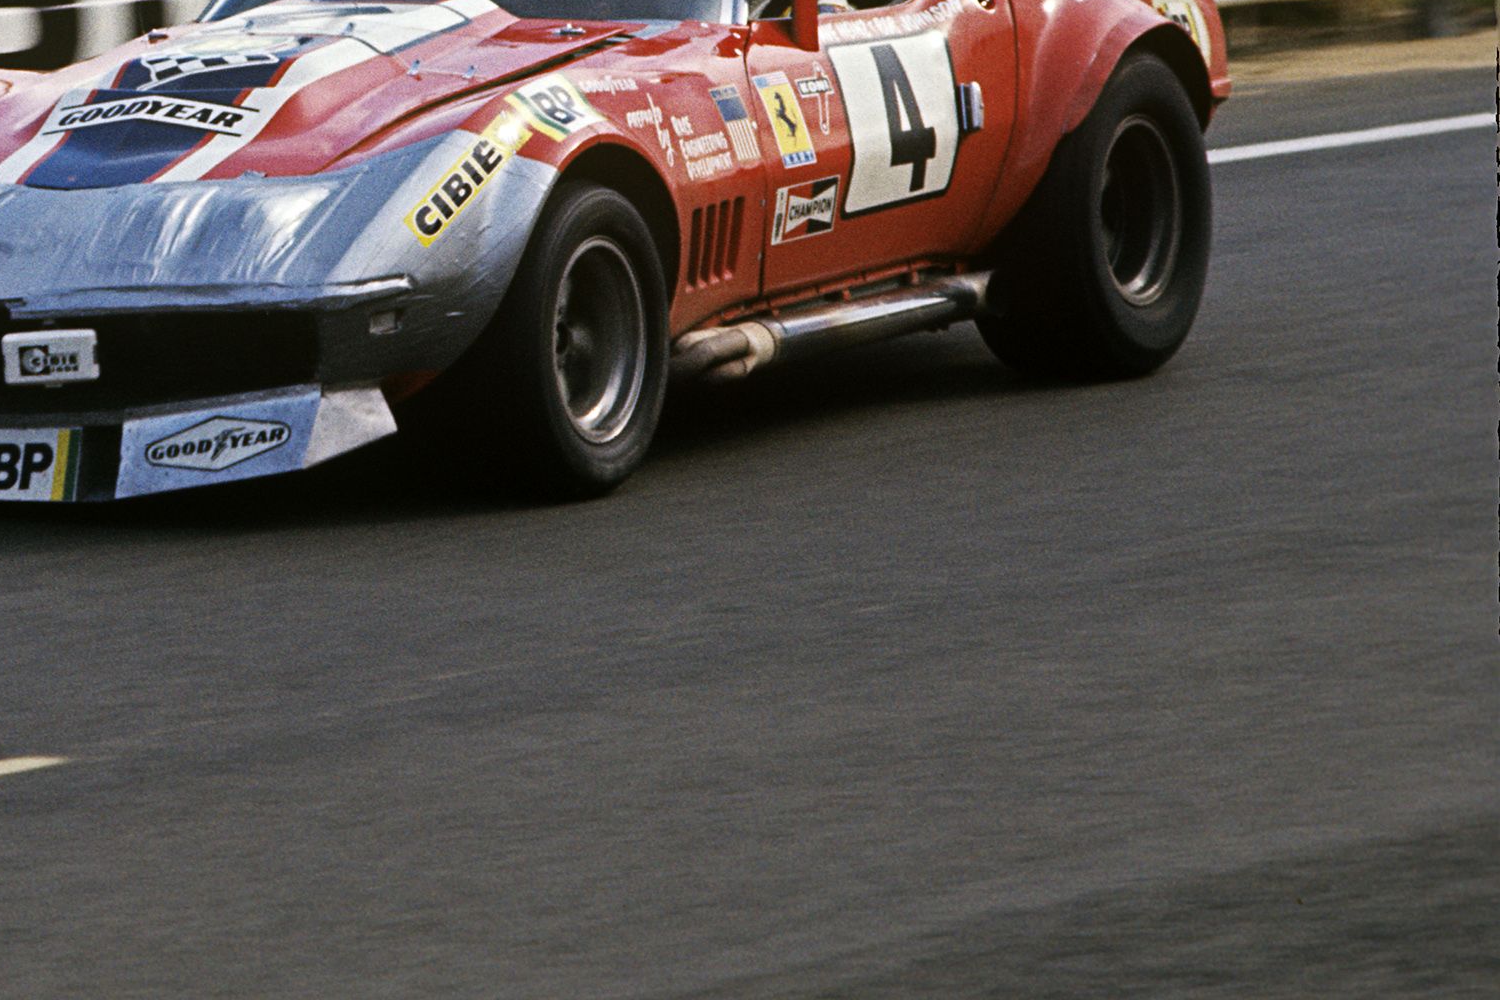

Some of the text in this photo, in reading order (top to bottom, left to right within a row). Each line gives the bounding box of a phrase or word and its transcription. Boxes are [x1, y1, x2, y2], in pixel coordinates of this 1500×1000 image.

[799, 79, 829, 95] KONI
[58, 101, 244, 128] GOODYEAR
[530, 85, 585, 125] BP
[870, 44, 937, 192] 4
[789, 198, 833, 221] CHAMPION
[151, 427, 285, 461] GOODYEAR
